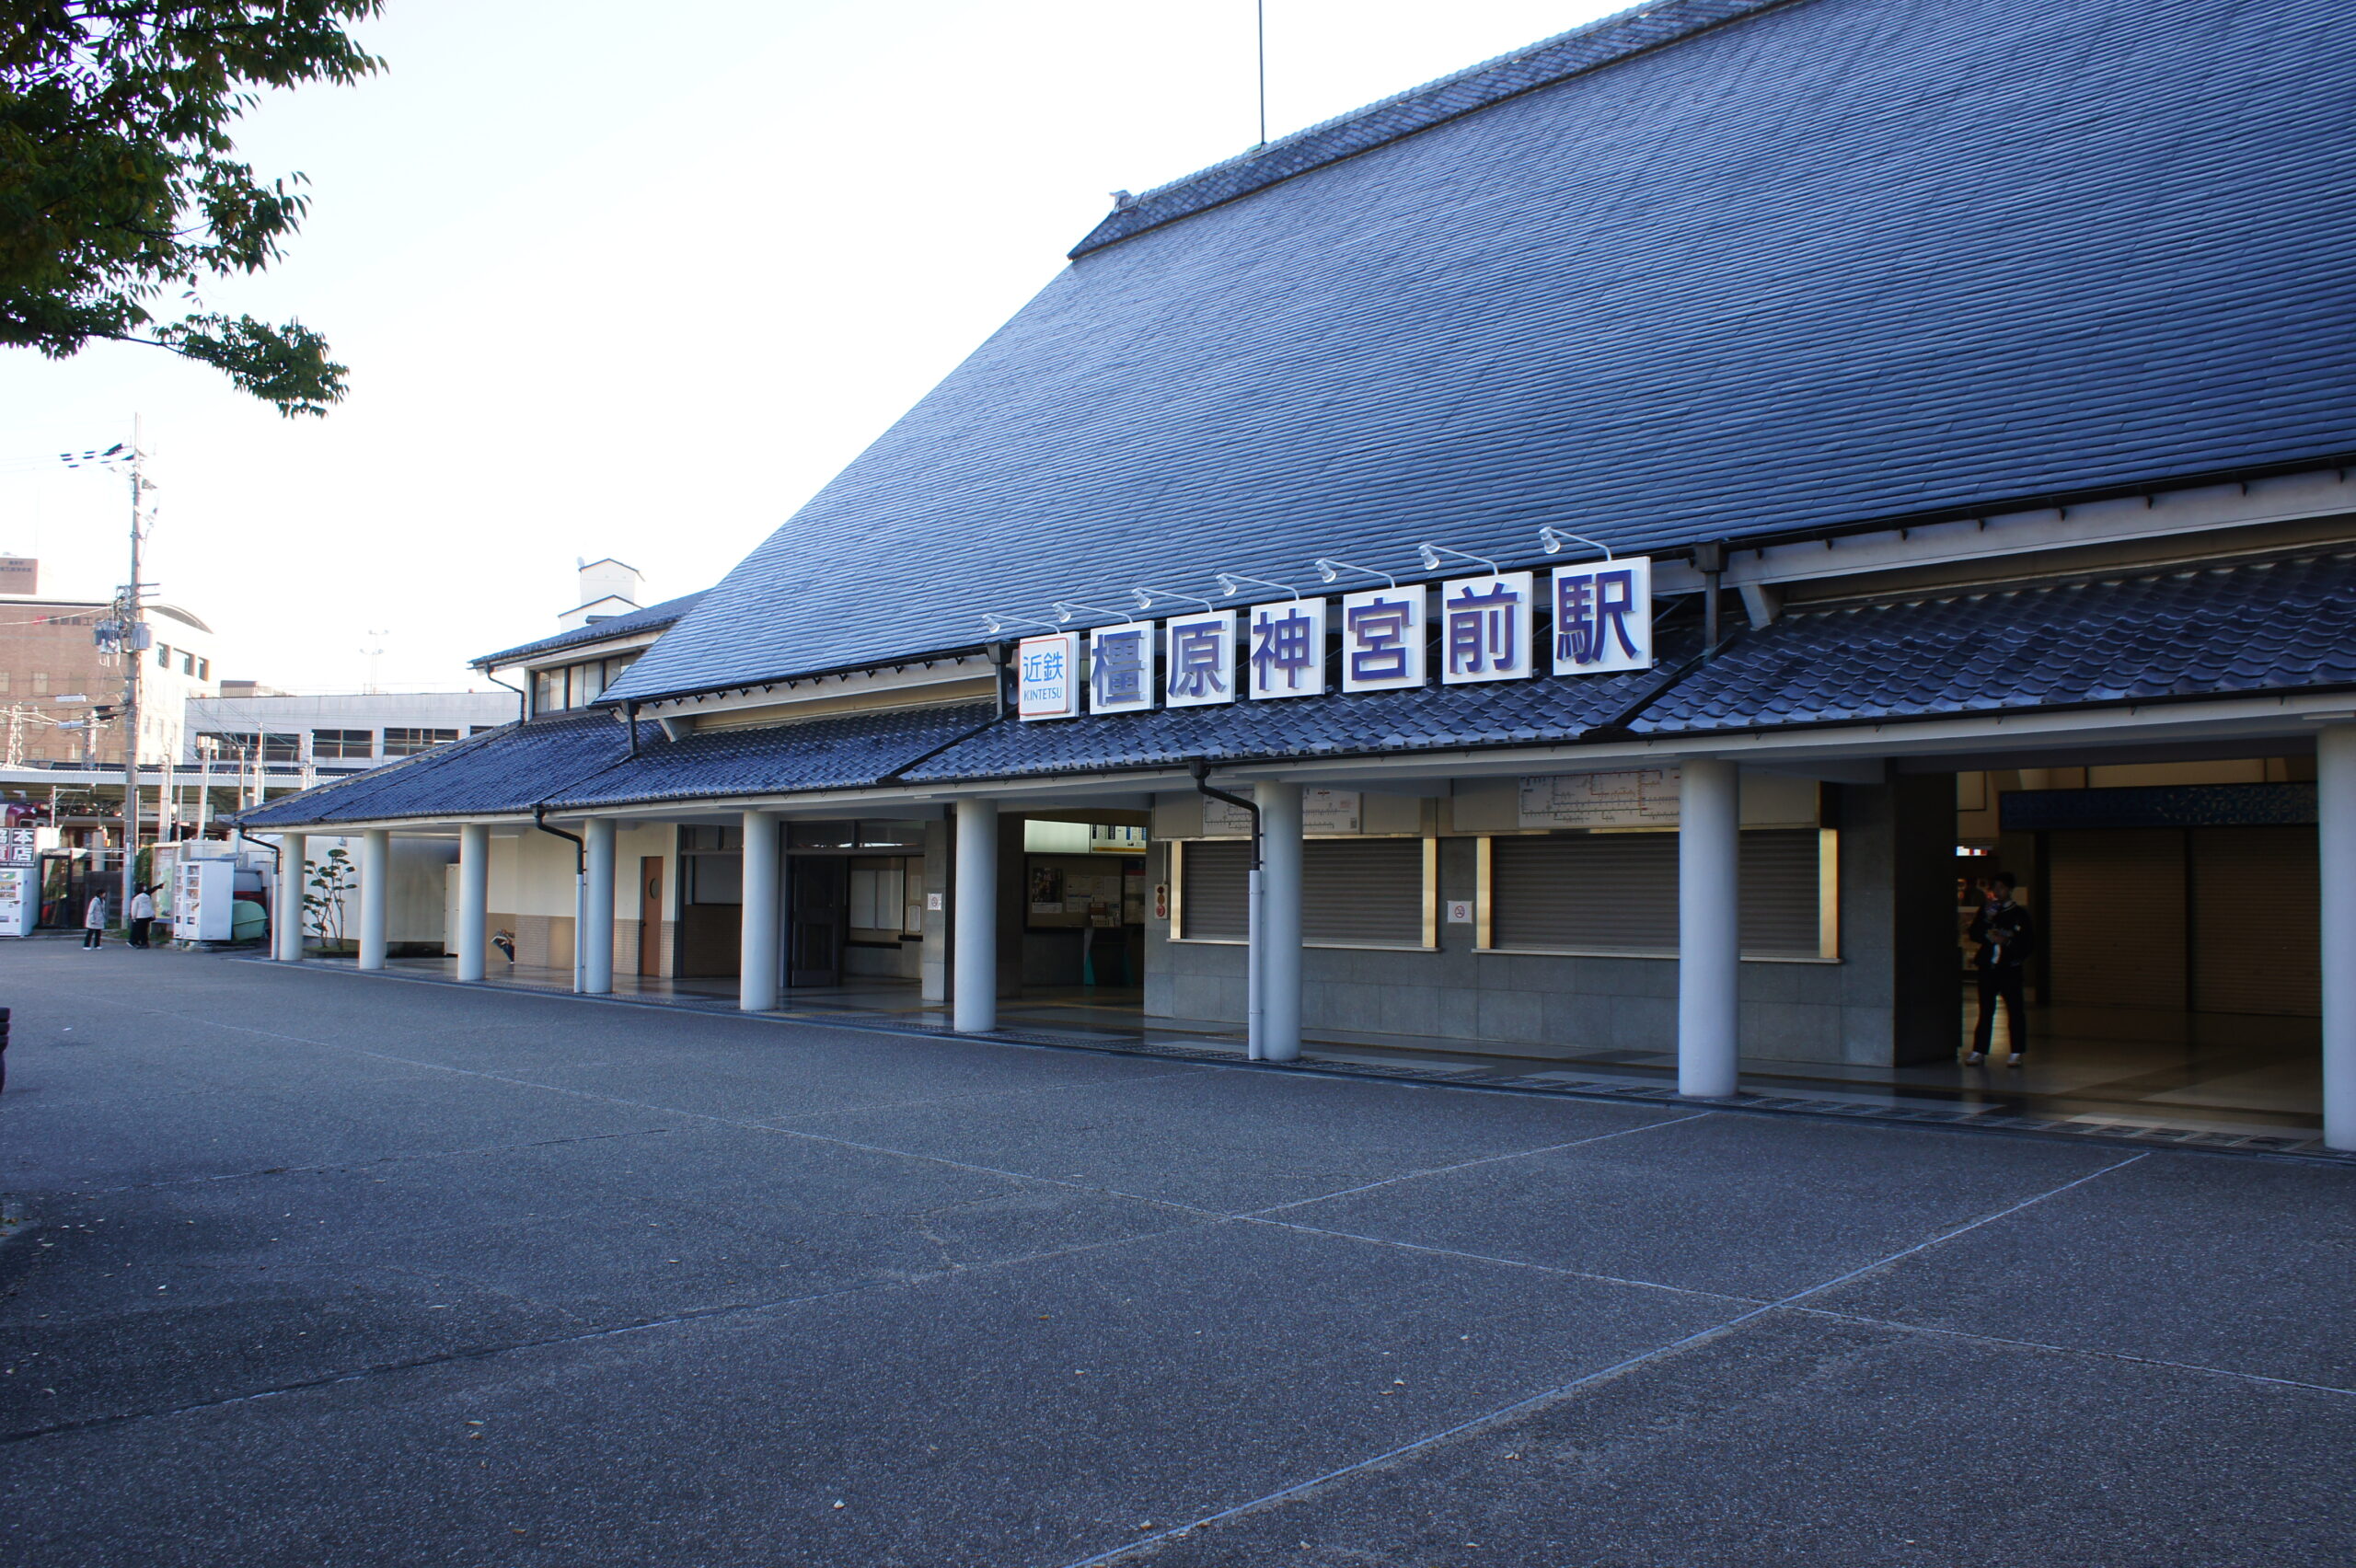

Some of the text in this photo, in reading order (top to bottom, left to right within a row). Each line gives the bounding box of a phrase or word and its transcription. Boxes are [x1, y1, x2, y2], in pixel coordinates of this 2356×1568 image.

[1091, 569, 1641, 707] 橿原神宮前駅
[1023, 651, 1063, 682] 近鉄
[1023, 687, 1061, 701] KINTETSU
